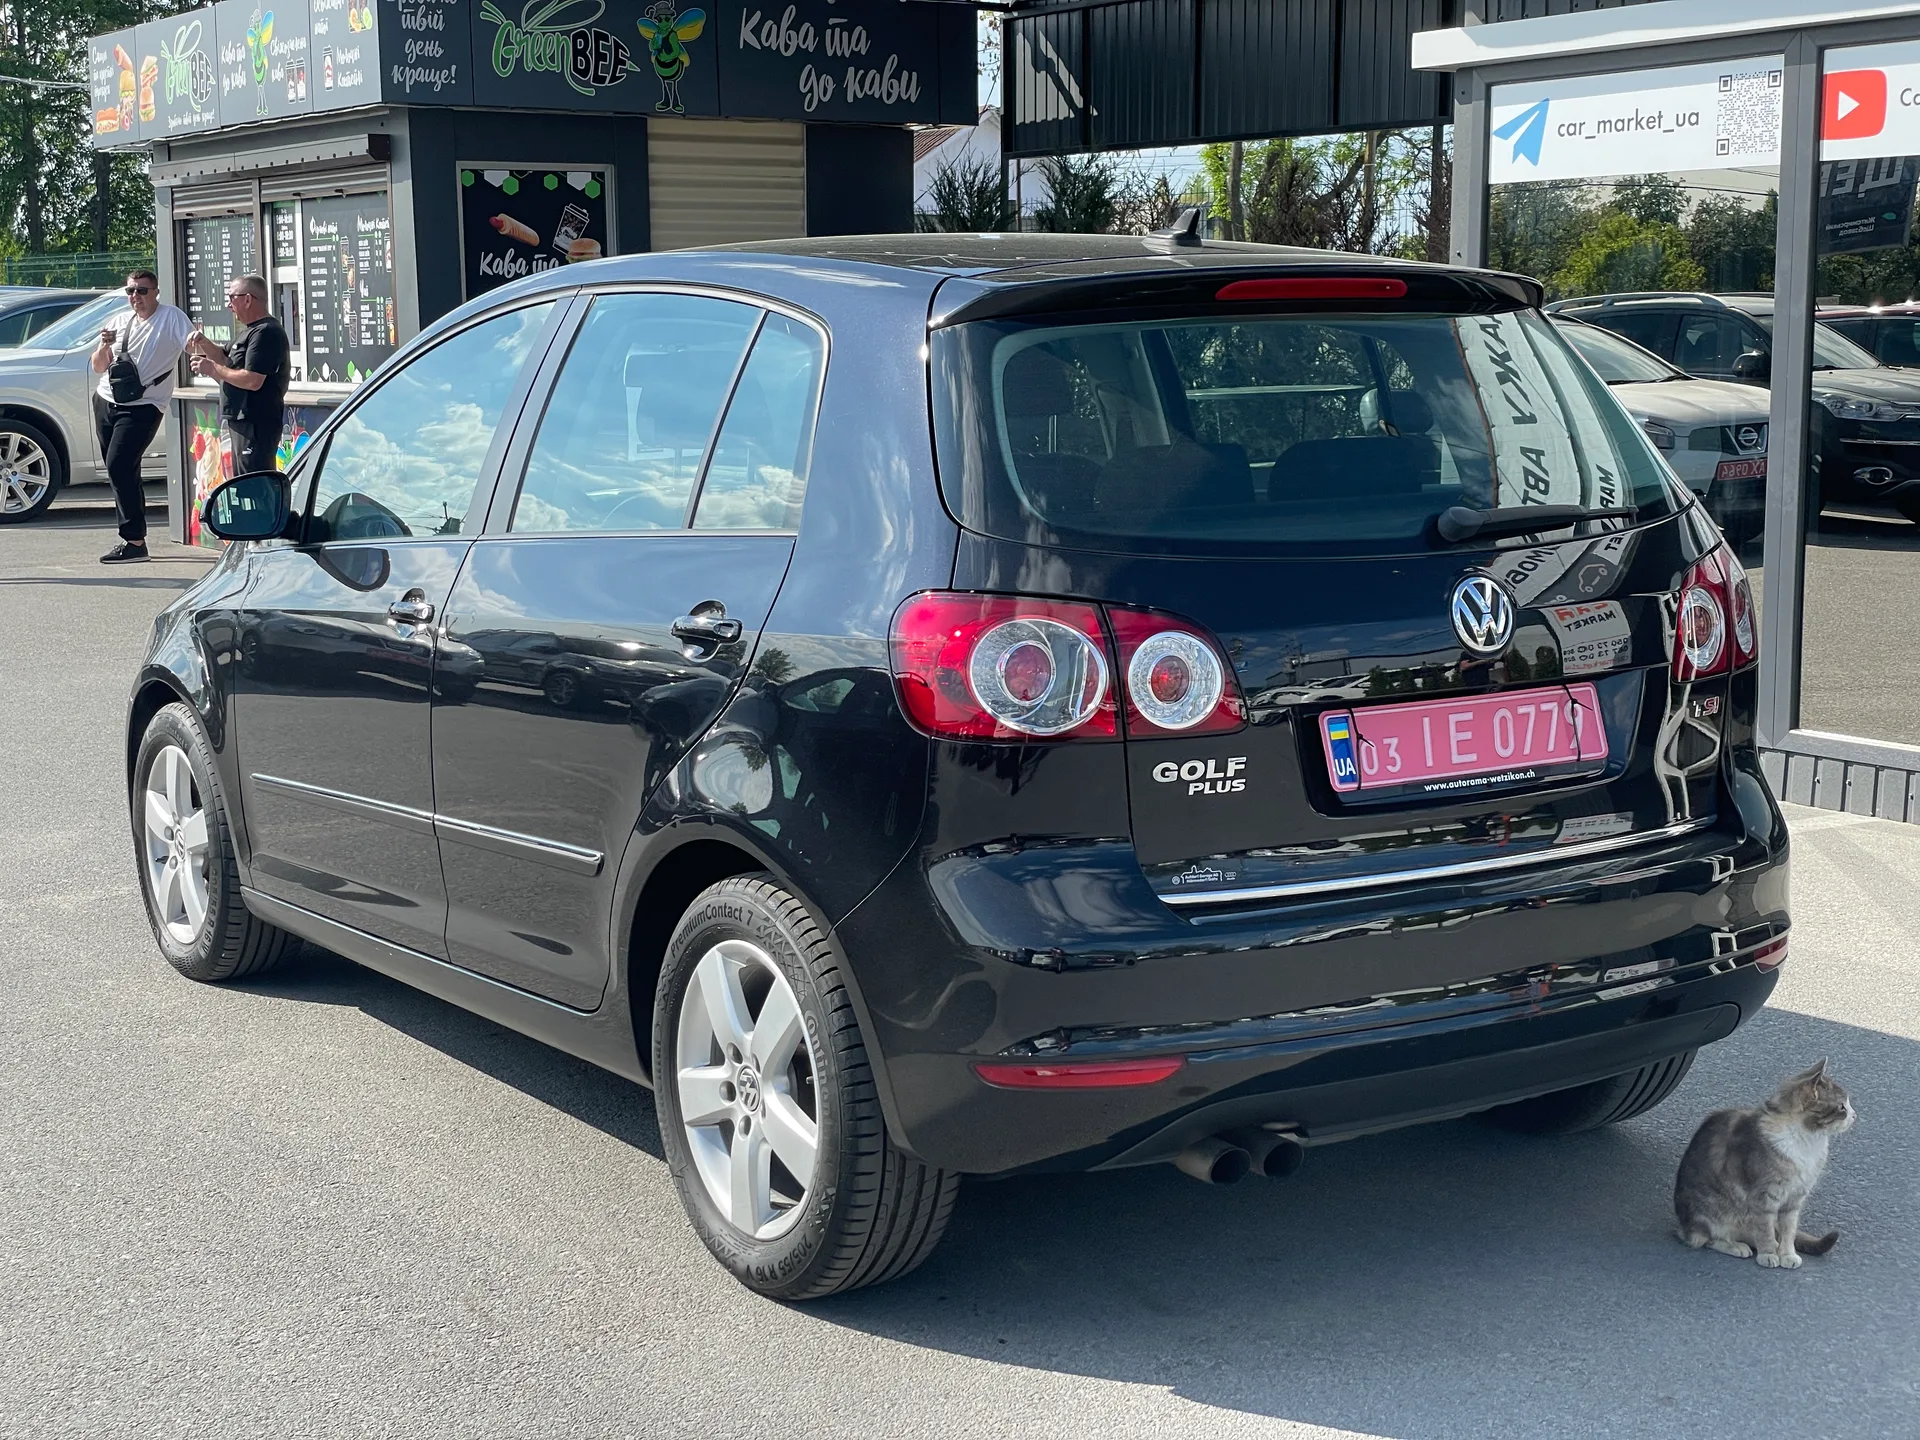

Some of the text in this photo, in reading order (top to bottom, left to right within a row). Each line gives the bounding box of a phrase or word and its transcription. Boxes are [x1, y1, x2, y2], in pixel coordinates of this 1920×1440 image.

[401, 5, 446, 32] твій
[739, 4, 871, 58] Кава та
[405, 38, 445, 64] день
[391, 64, 457, 93] краще!
[799, 54, 921, 112] до кави
[1557, 108, 1700, 140] car_market_ua
[479, 248, 529, 279] Кава
[1361, 736, 1401, 776] 03
[1493, 700, 1585, 759] 0779
[1152, 756, 1247, 783] GOLF
[1334, 758, 1356, 777] UA
[1424, 768, 1536, 792] www.autorama-wetzikon.ch
[1188, 779, 1246, 796] PLUS
[671, 902, 754, 959] PremiumContact 7
[777, 1233, 812, 1277] 205/55
